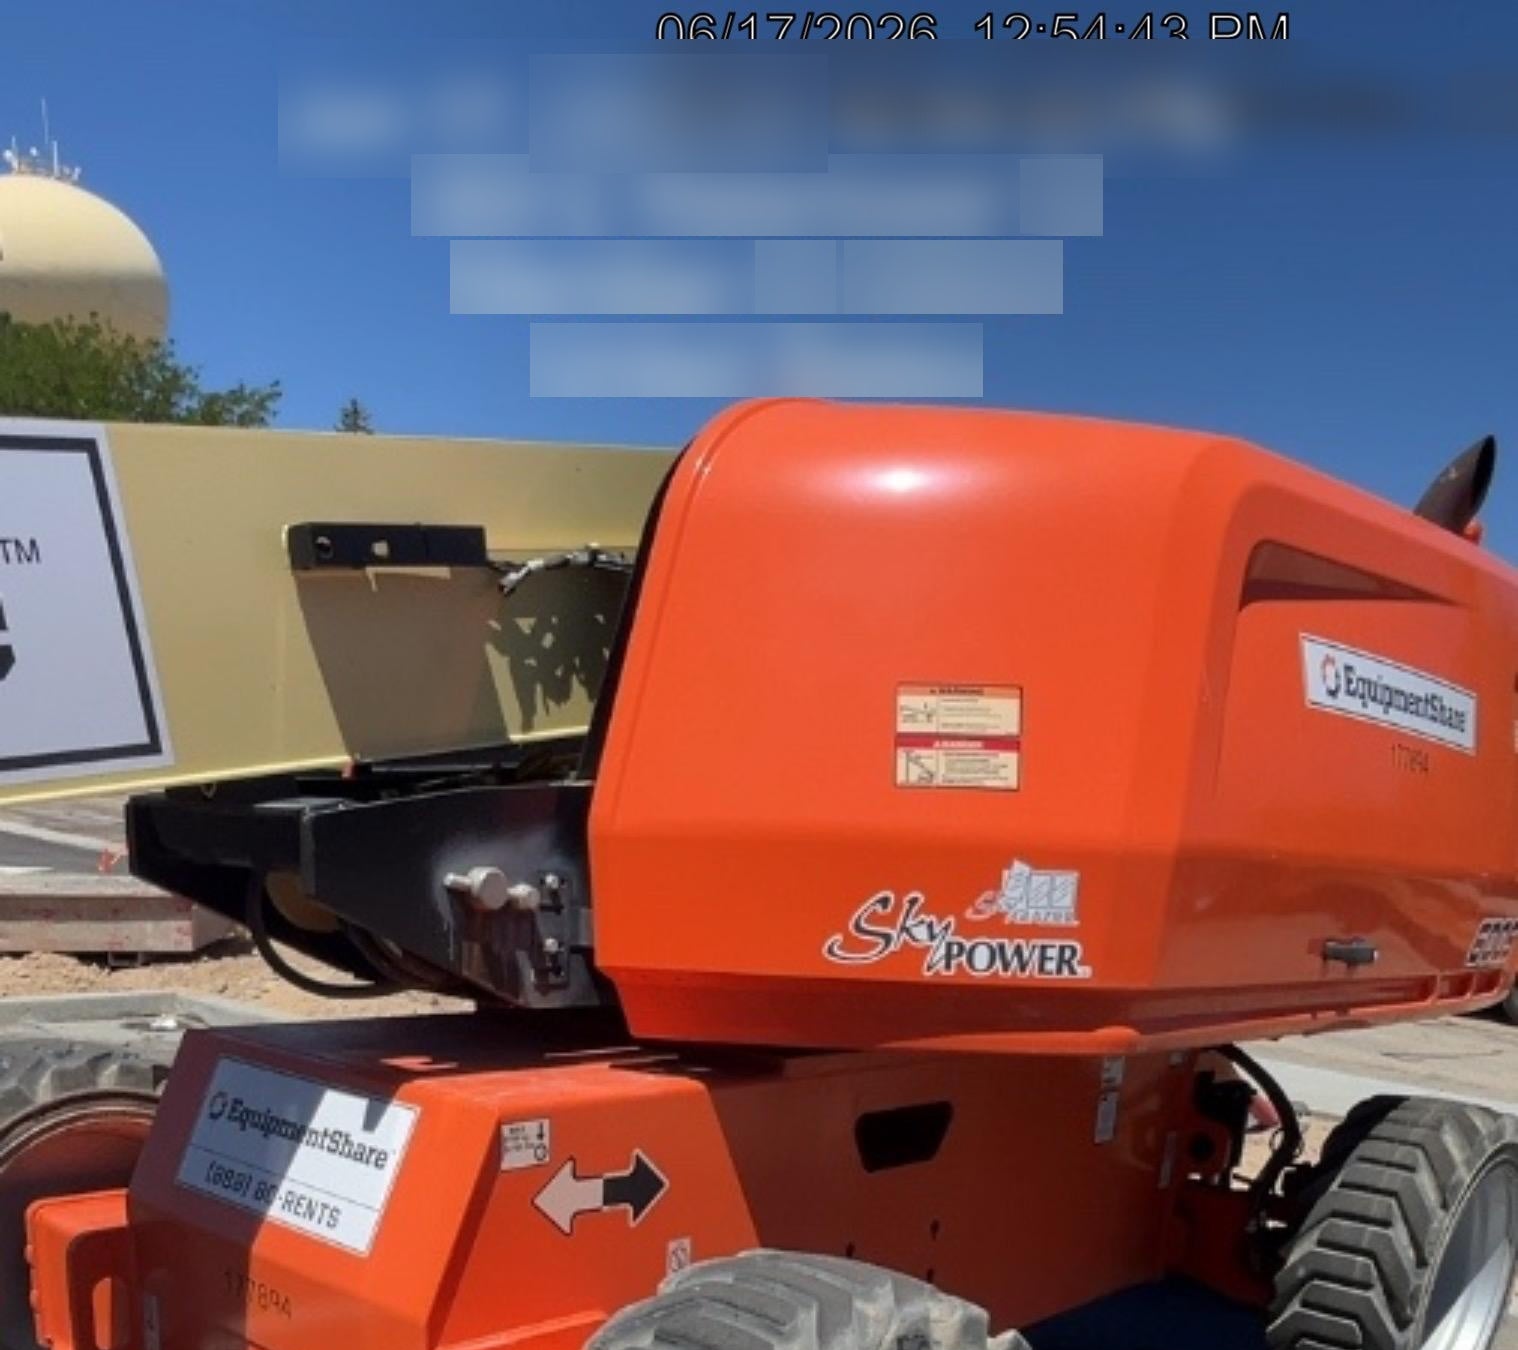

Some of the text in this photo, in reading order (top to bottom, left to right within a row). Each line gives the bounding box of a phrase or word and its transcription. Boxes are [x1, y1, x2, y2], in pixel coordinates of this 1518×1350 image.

[1342, 663, 1466, 733] EquipmentShare
[824, 892, 953, 975] Sky
[943, 938, 1081, 976] POWER
[227, 1097, 389, 1170] EquipmentShare
